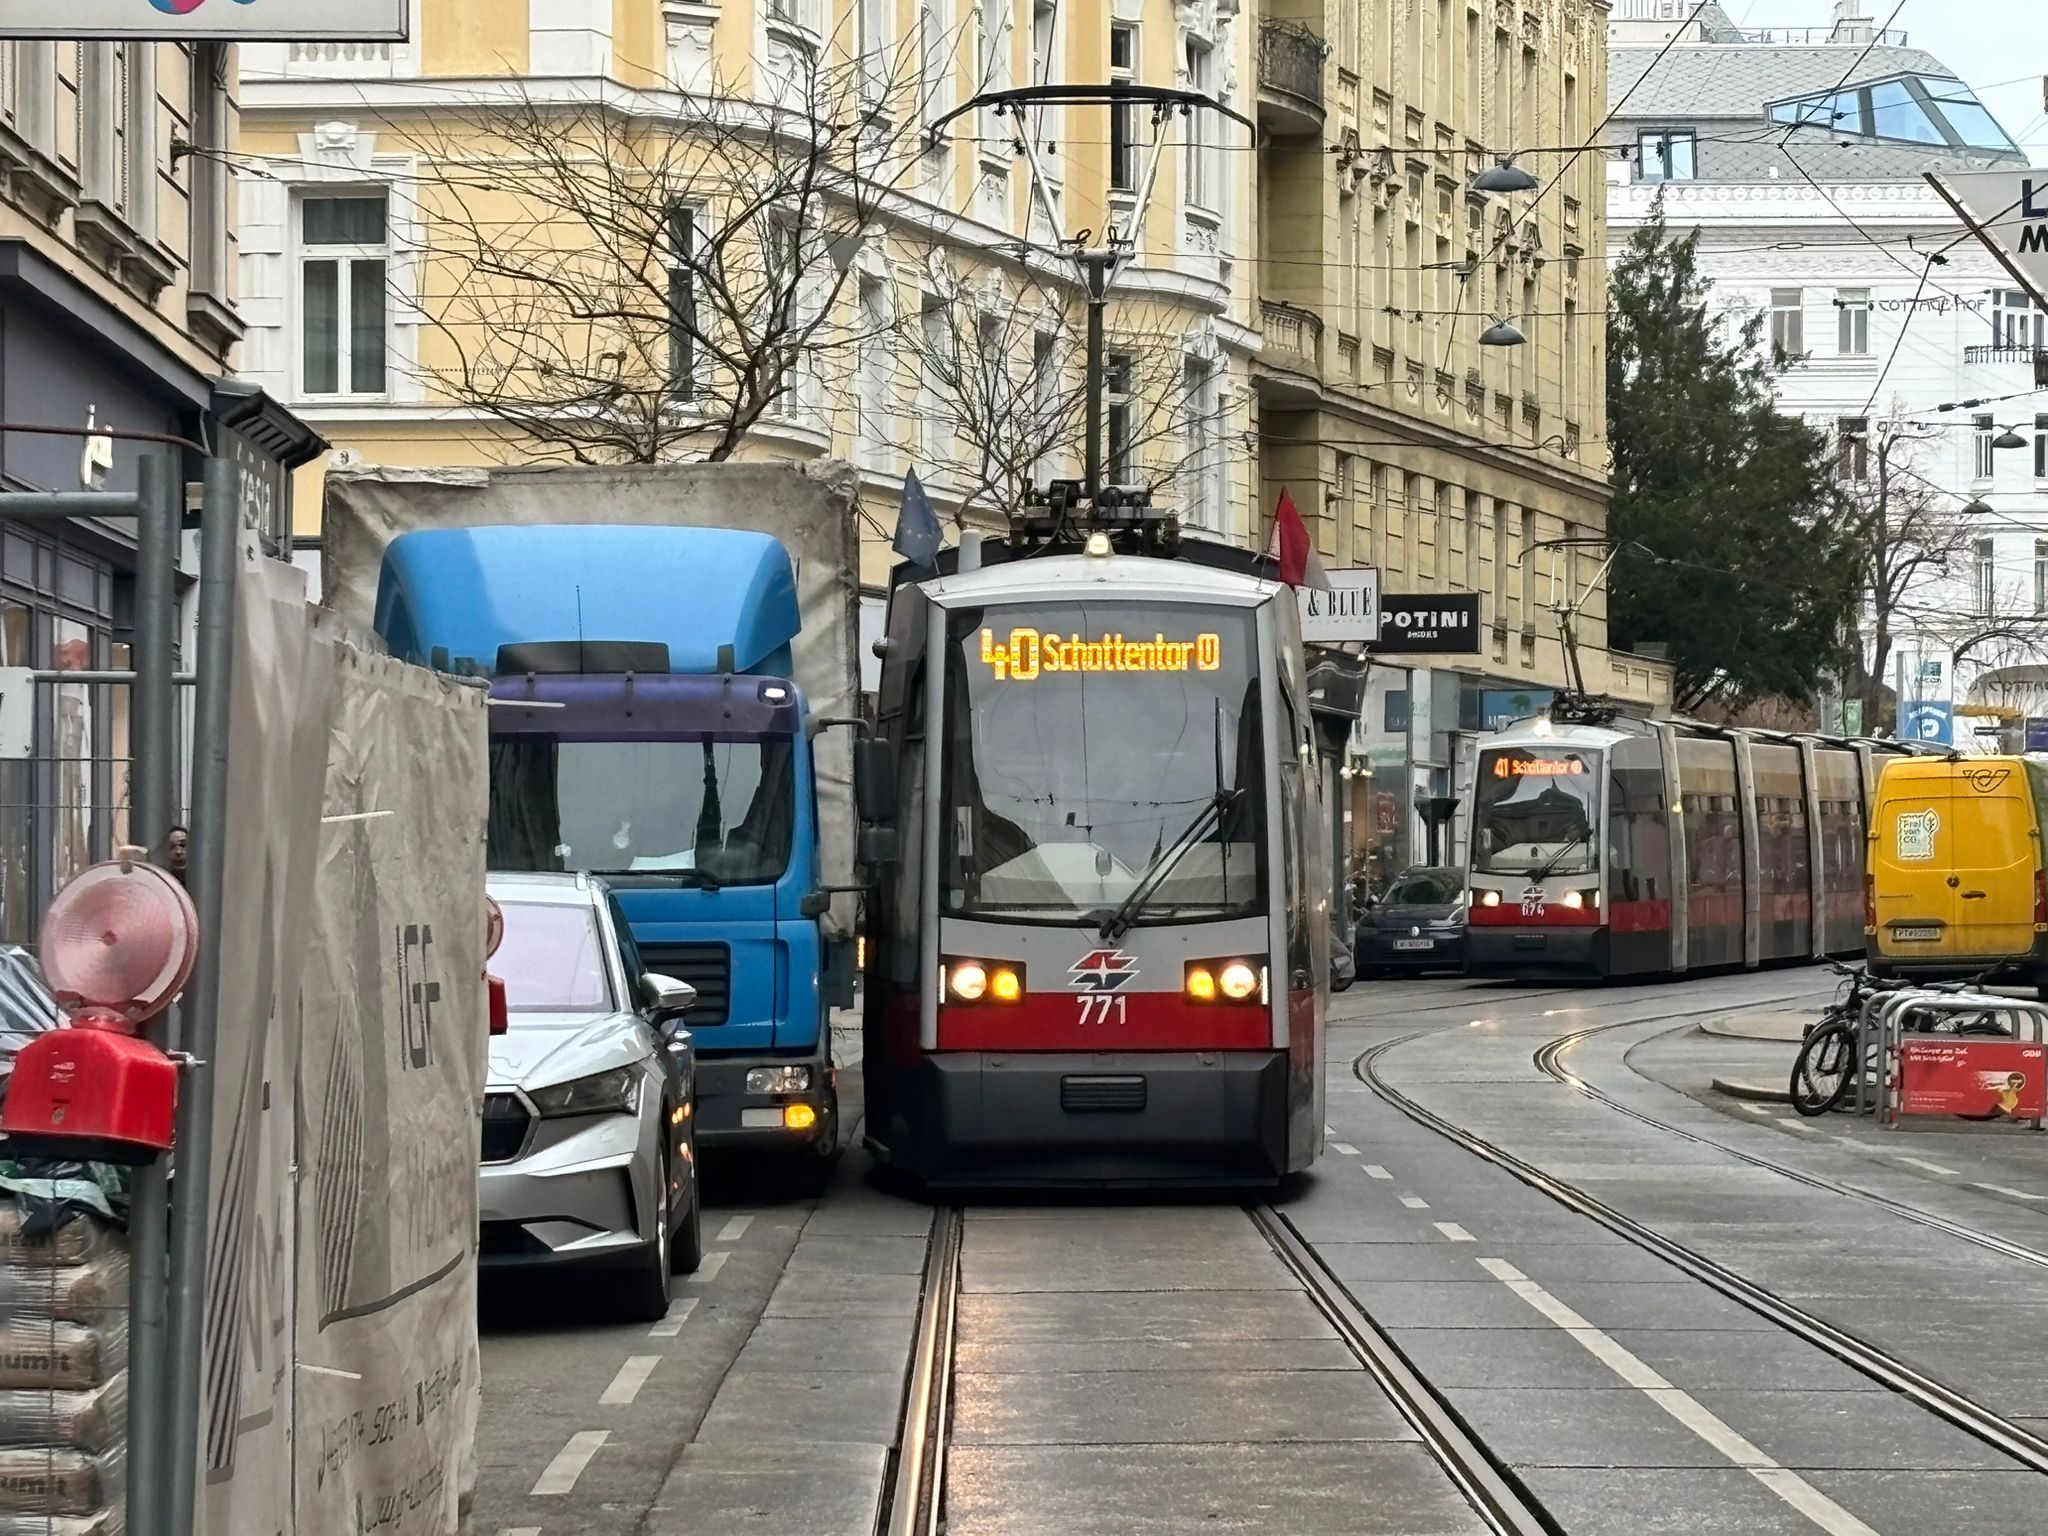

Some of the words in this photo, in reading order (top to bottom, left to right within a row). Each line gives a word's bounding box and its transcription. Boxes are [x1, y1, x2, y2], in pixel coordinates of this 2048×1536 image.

[1307, 587, 1320, 617] &
[1328, 586, 1373, 616] BLUE
[1381, 610, 1469, 628] POTINI
[980, 627, 1040, 681] 40
[1042, 633, 1195, 672] Schottentor
[1493, 758, 1509, 779] 41
[1076, 994, 1126, 1025] 771
